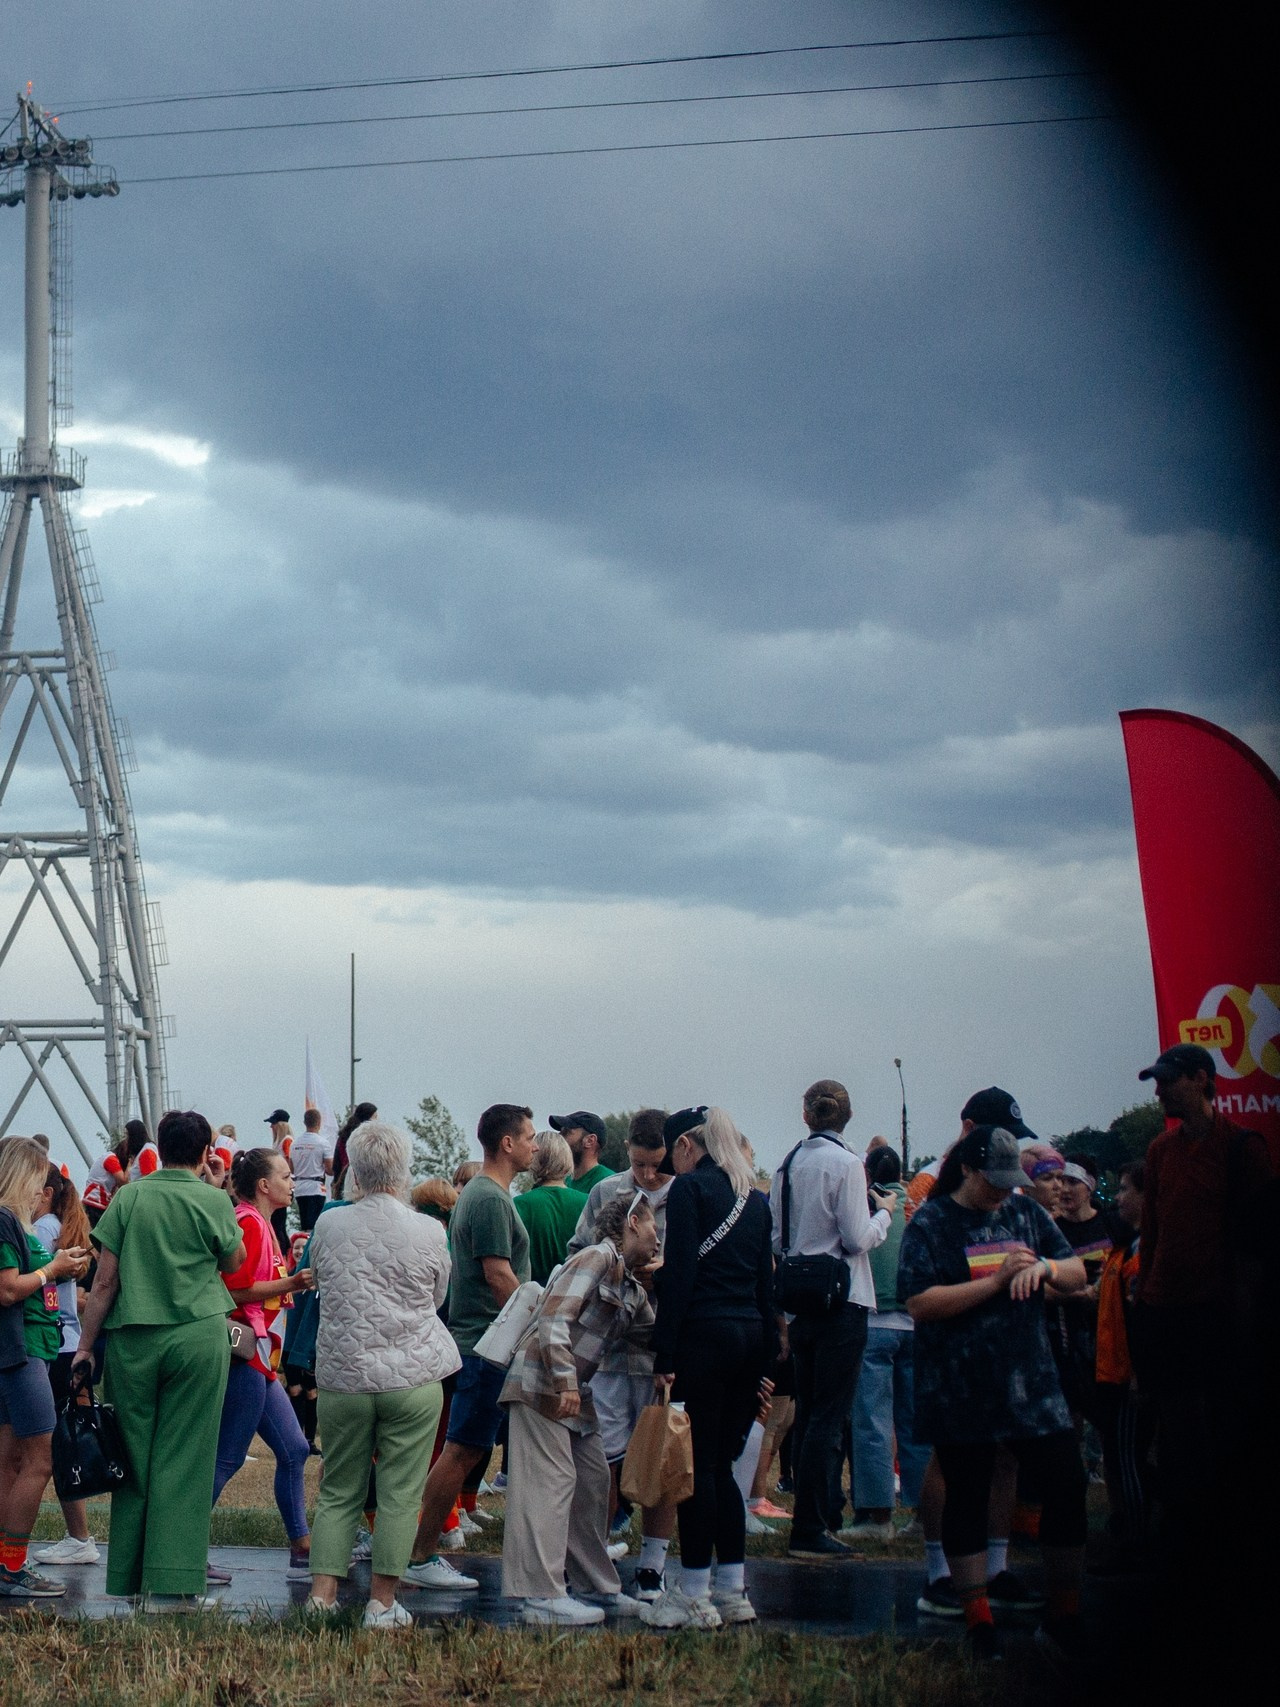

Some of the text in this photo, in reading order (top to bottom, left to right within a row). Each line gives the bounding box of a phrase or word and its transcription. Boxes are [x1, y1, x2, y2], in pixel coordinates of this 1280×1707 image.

[698, 1237, 716, 1257] NICE
[711, 1221, 730, 1242] NICE
[725, 1207, 740, 1228] NICE
